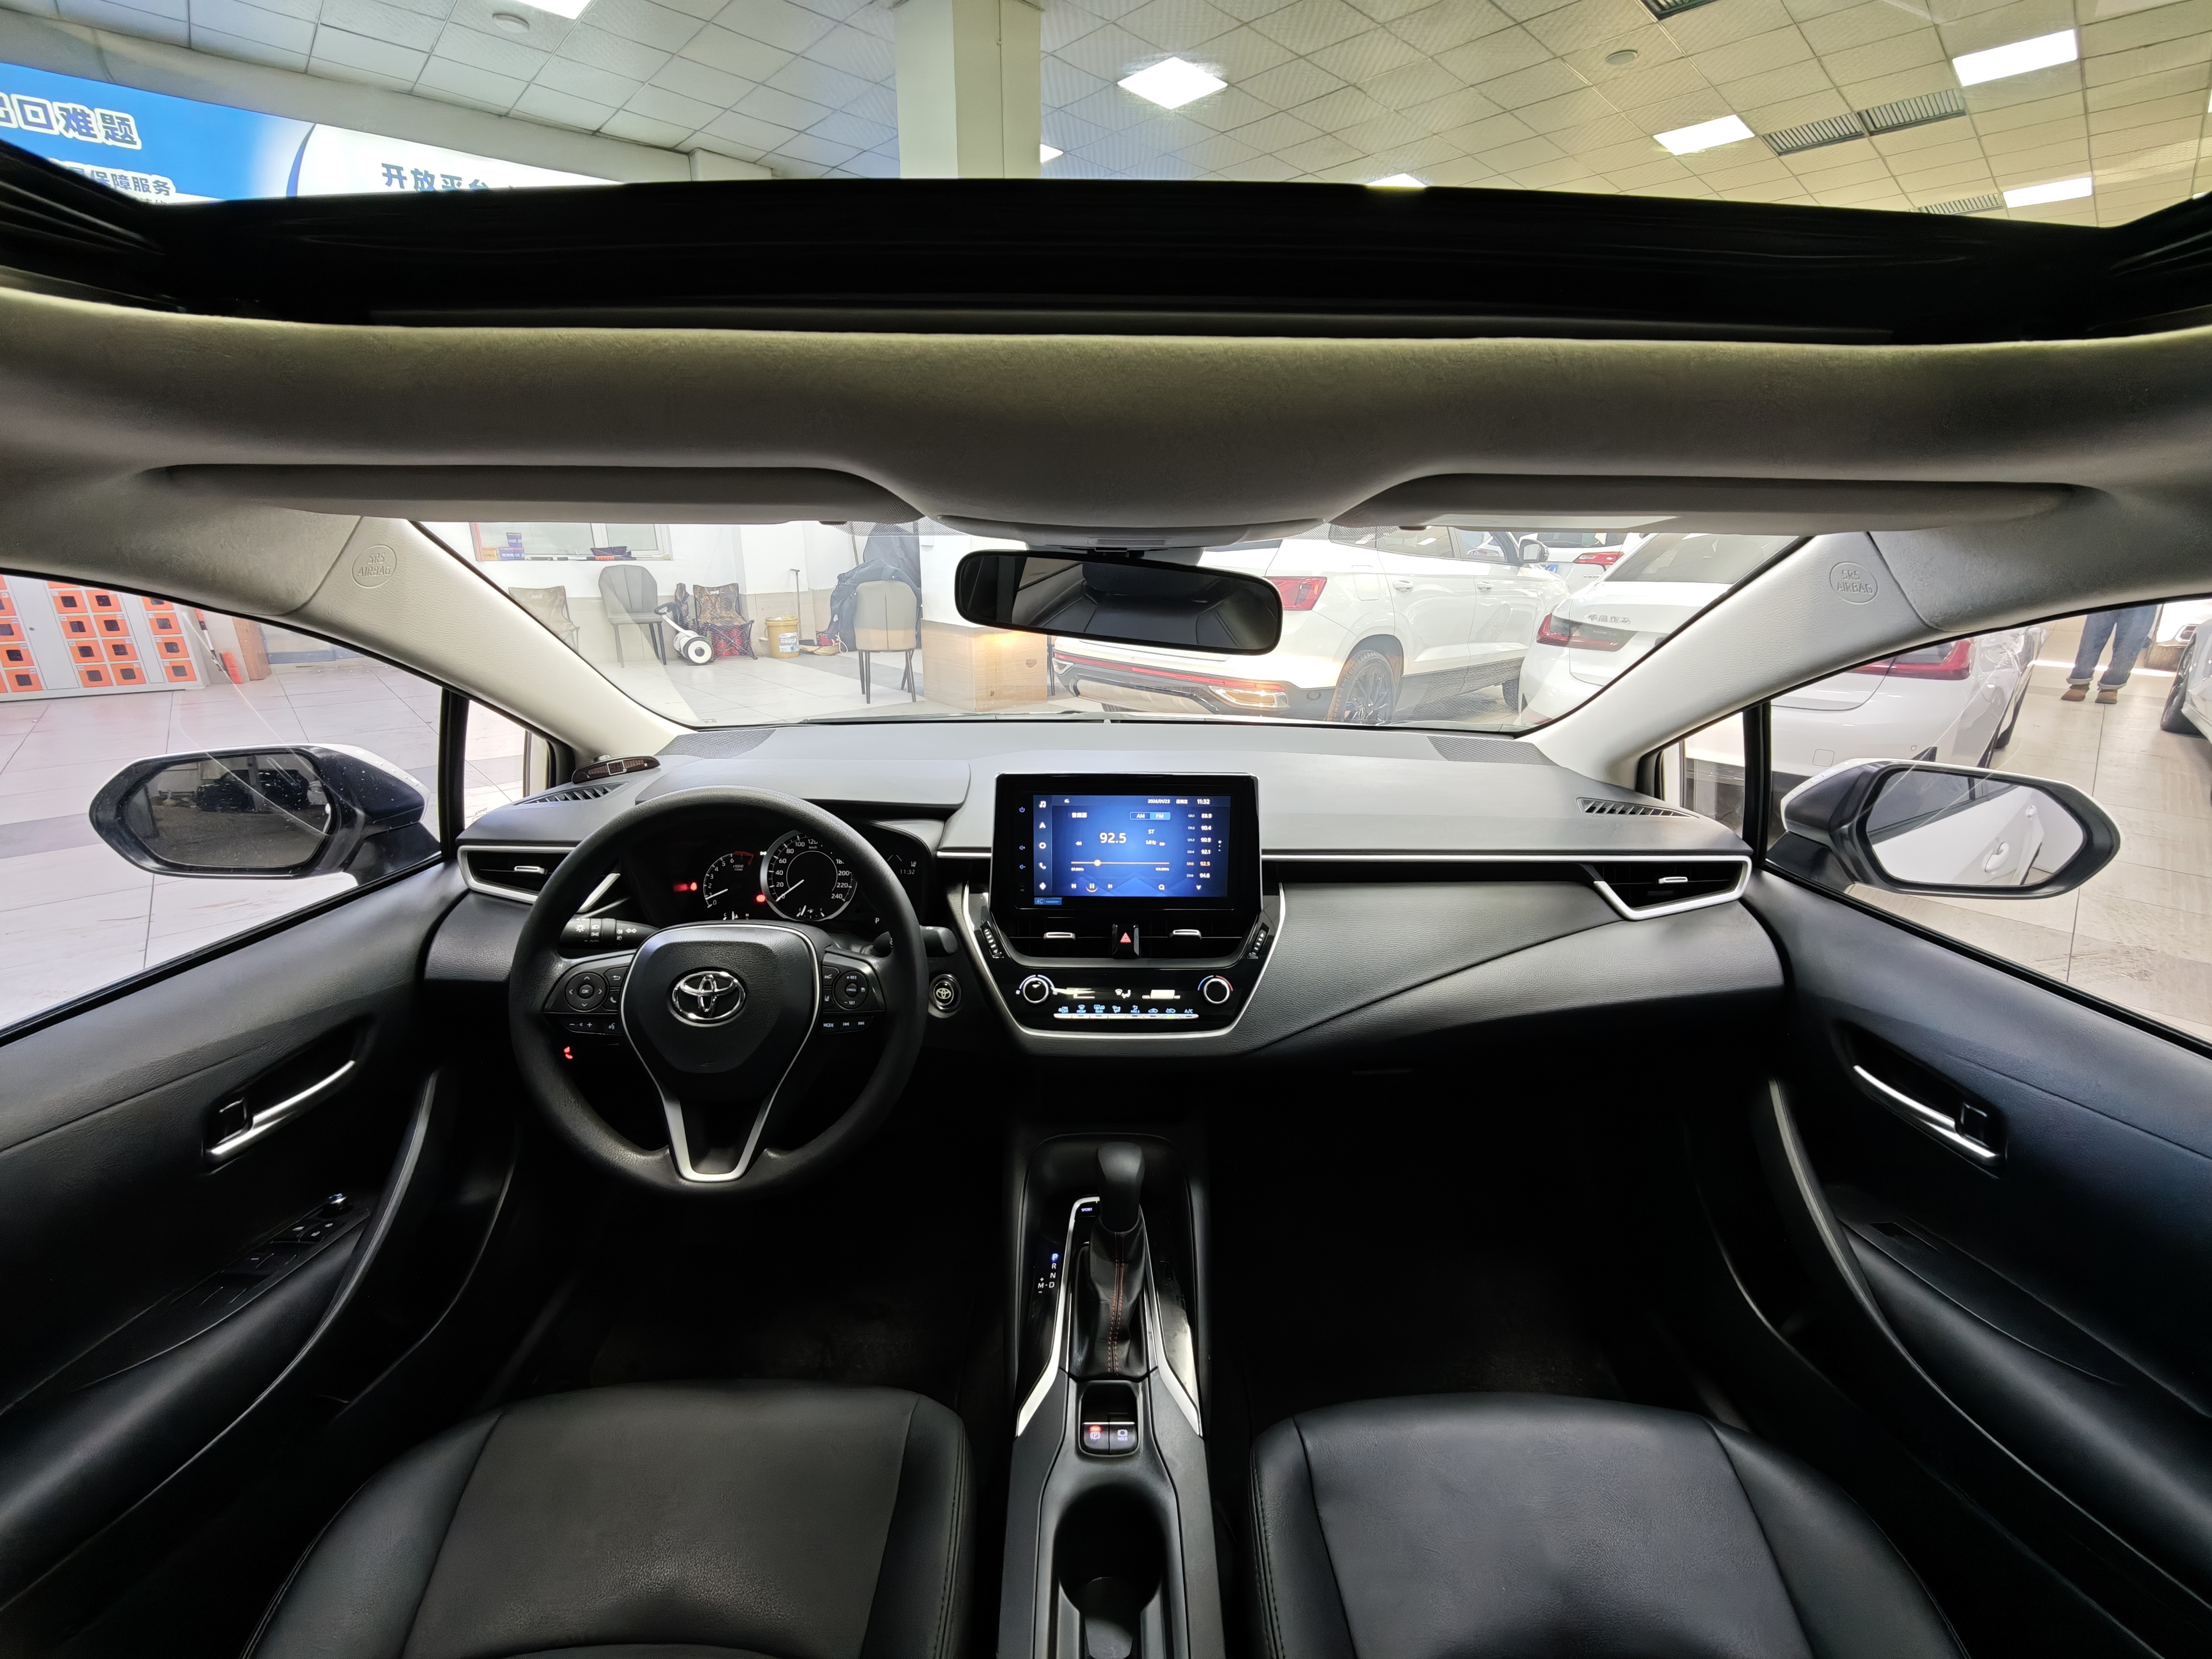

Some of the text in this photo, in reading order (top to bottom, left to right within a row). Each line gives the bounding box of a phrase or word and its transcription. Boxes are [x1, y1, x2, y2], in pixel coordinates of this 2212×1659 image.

[69, 166, 170, 196] 保障服务
[367, 552, 386, 565] SRS
[357, 565, 392, 577] AIRBAG
[1842, 569, 1860, 581] SRS
[1837, 582, 1873, 594] AIRBAG
[1100, 832, 1127, 844] 92.5
[1051, 1253, 1058, 1262] P
